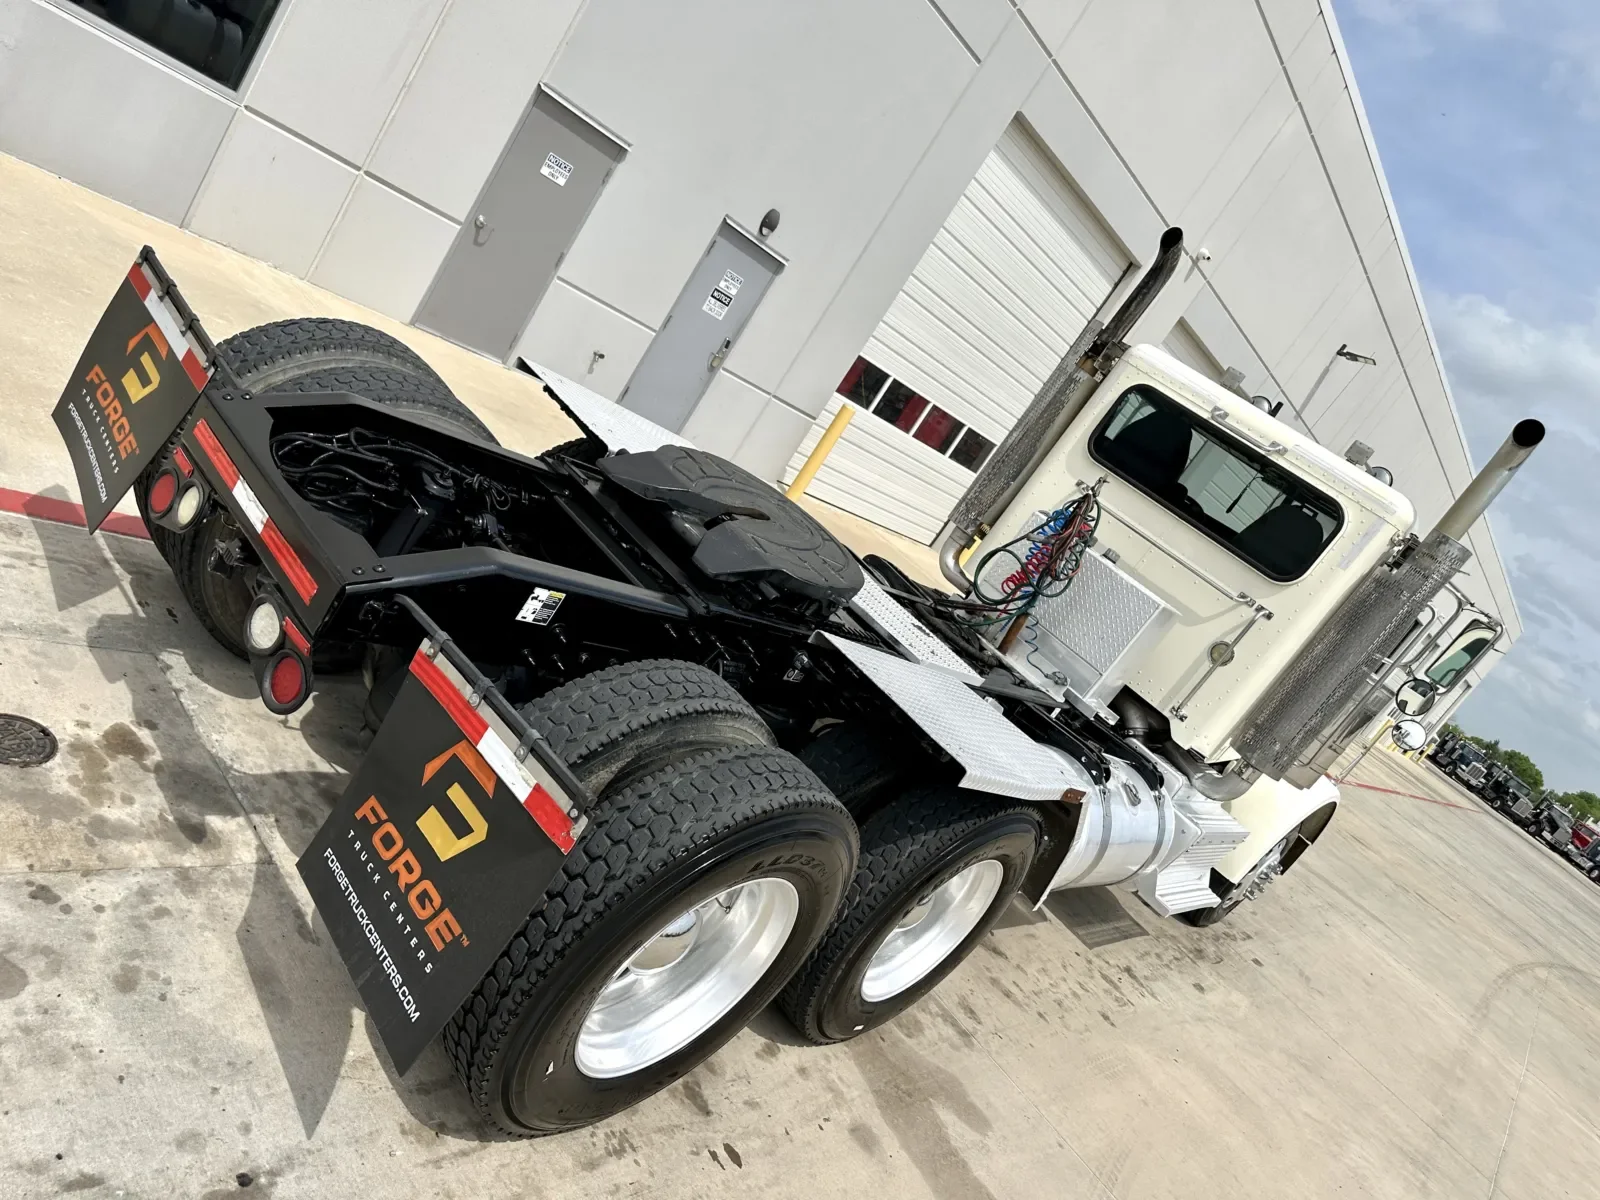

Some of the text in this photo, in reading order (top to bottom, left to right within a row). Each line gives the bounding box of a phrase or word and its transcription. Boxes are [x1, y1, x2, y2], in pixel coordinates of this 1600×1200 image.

[544, 162, 569, 180] EMPLOYEES
[548, 171, 560, 180] ONLY
[549, 154, 572, 174] NOTICE
[712, 289, 731, 305] NOTICE
[67, 401, 108, 504] FORGETRUCKCENTERS.COM
[81, 388, 120, 474] TRUCK CENTERS
[85, 363, 137, 460] FORGE
[347, 829, 433, 974] TRUCK CENTERS
[354, 794, 462, 953] FORGE
[323, 847, 421, 1023] FORGETRUCKCENTERS.COM
